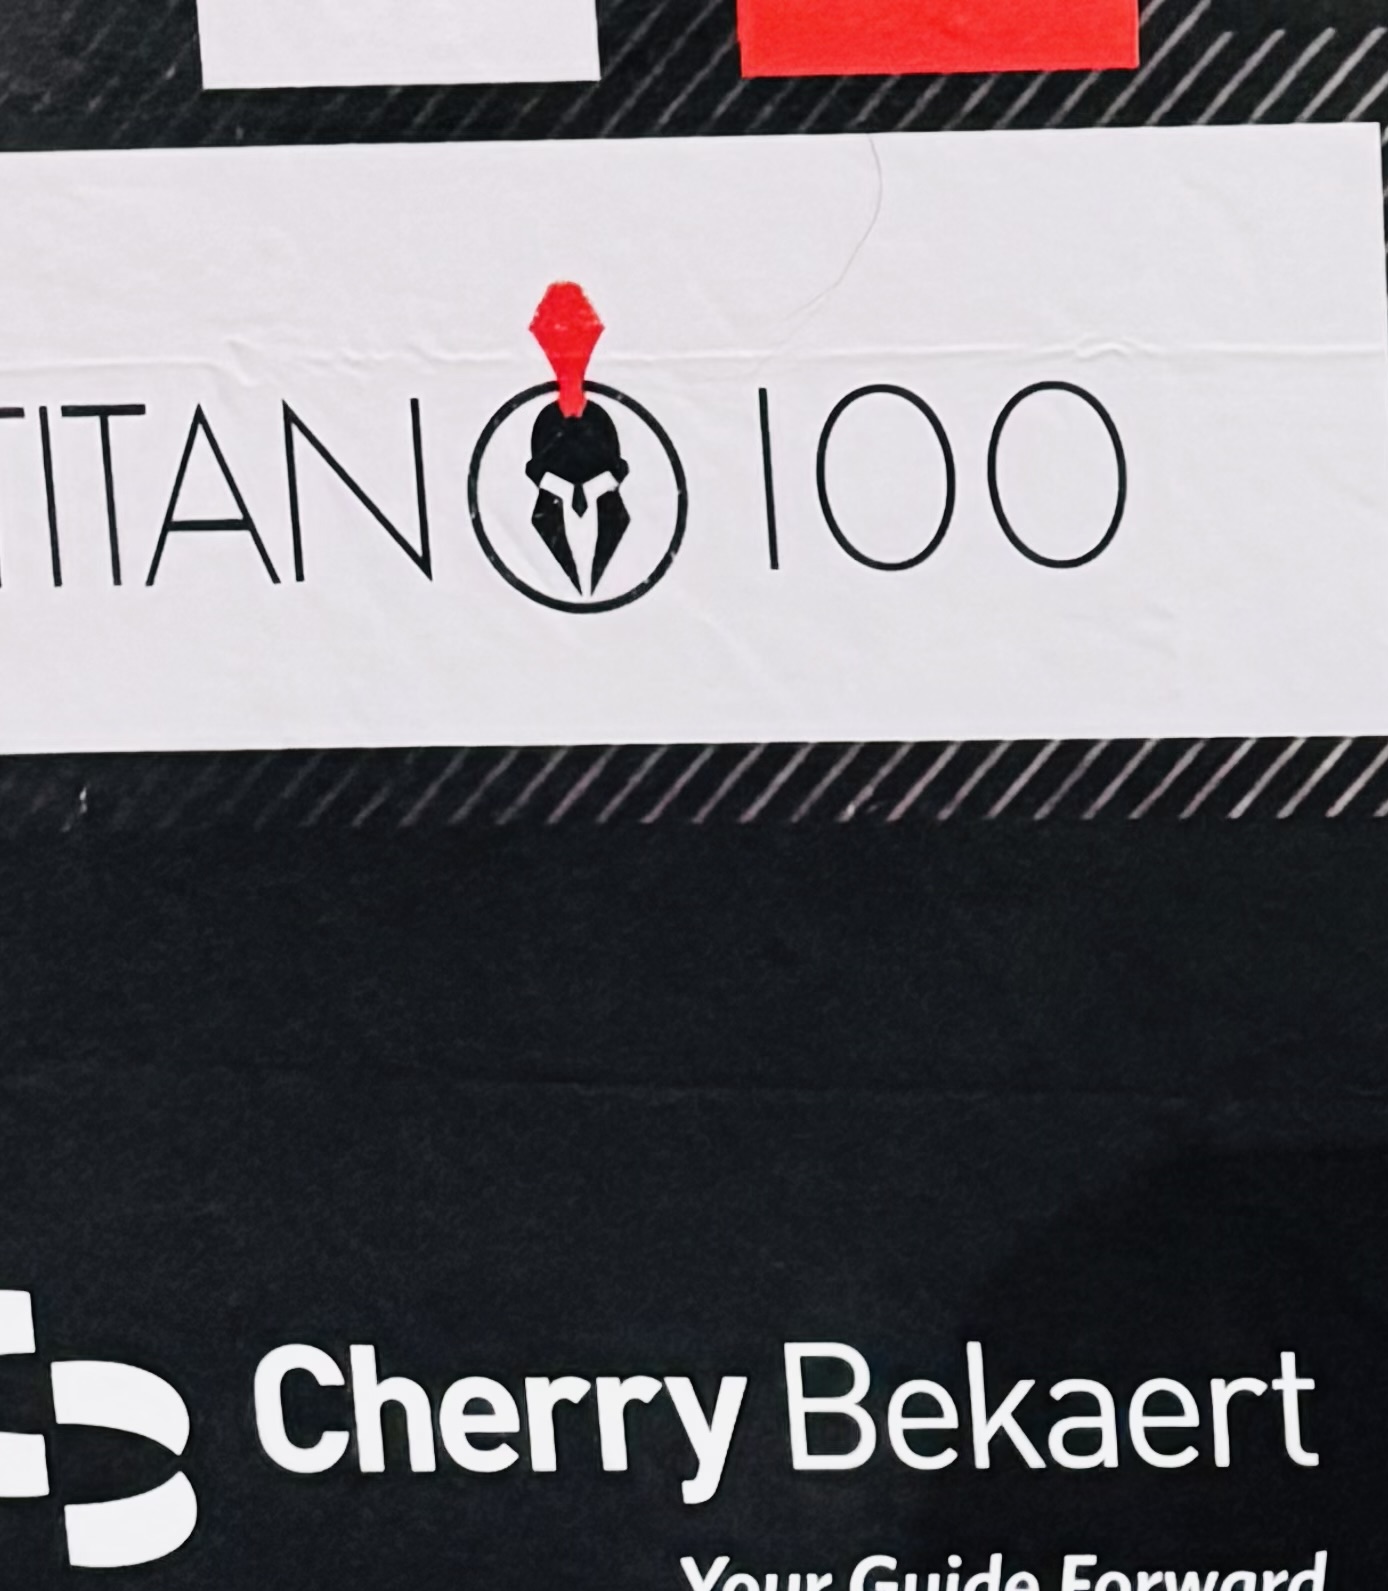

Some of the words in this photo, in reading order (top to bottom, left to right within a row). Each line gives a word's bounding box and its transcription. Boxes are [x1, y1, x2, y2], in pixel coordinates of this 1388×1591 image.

[758, 380, 1128, 572] 100
[253, 1343, 748, 1505] Cherry
[783, 1340, 1320, 1471] Bekaert
